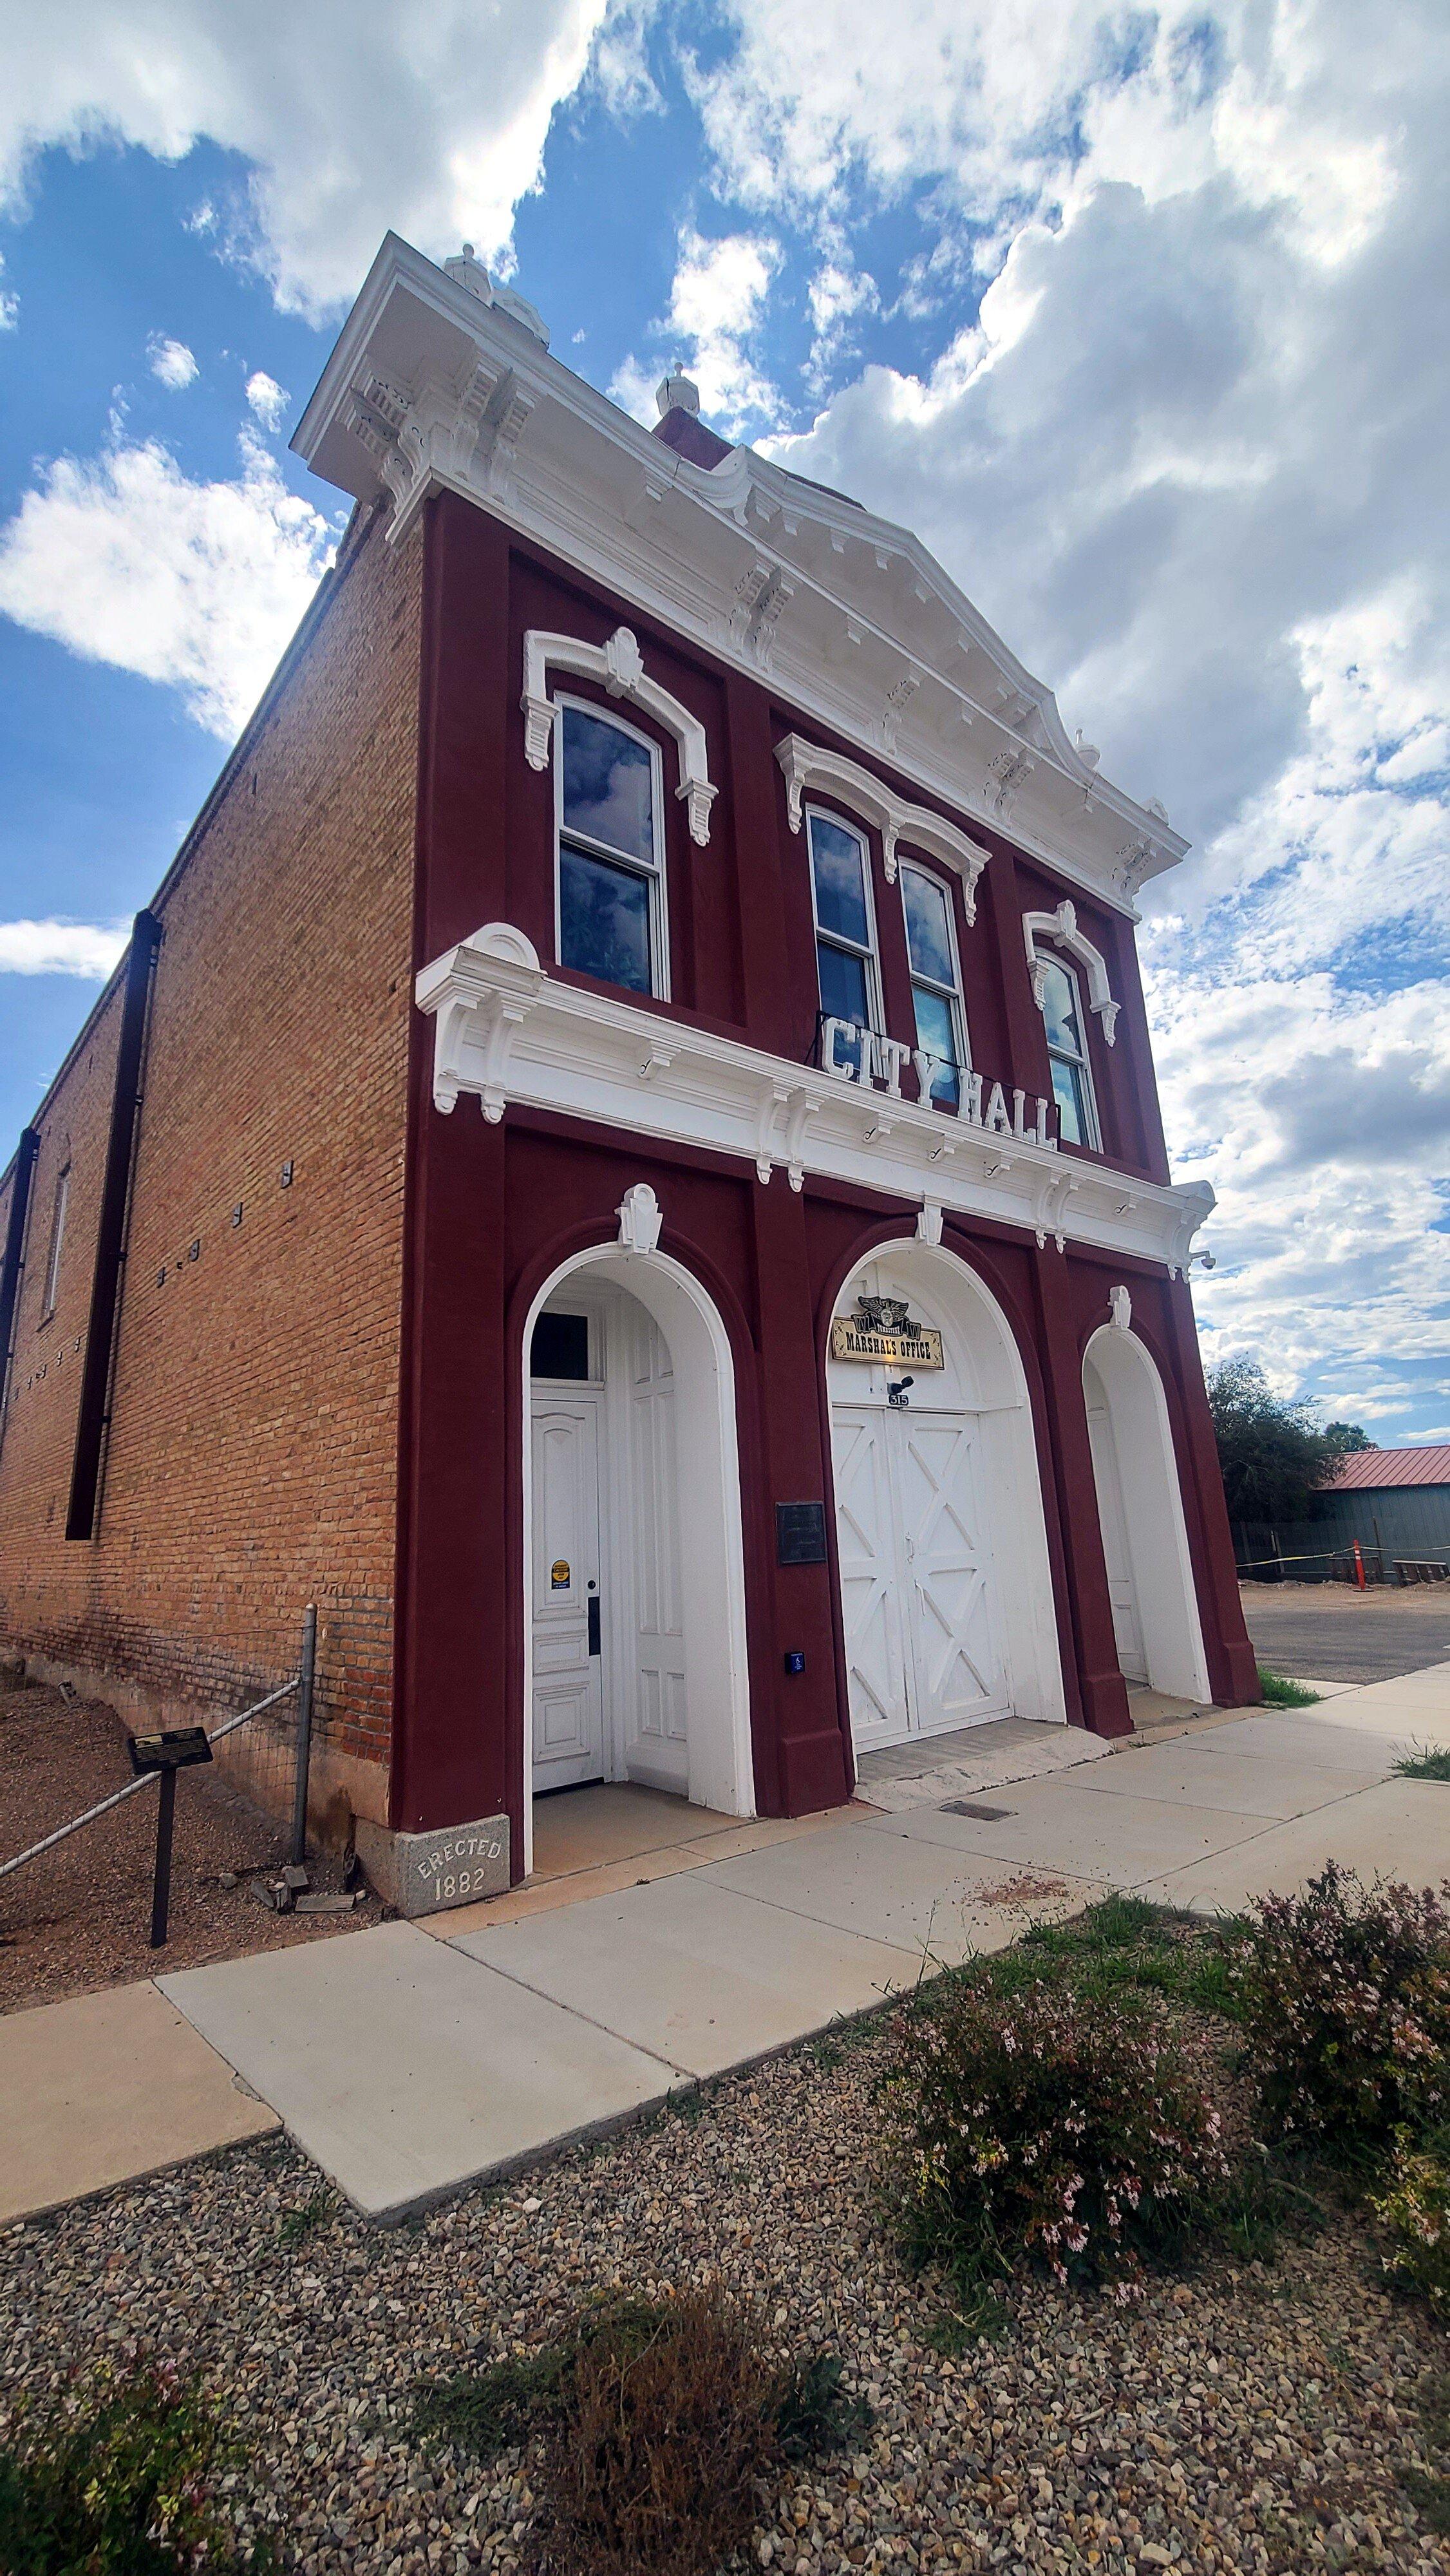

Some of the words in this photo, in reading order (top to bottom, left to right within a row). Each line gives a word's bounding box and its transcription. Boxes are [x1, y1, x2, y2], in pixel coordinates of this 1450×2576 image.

[822, 1017, 940, 1110] CITY
[957, 1067, 1058, 1151] HALL
[845, 1332, 897, 1356] MARSHAL'S
[900, 1341, 931, 1359] OFFICE
[890, 1395, 908, 1405] 315
[418, 1839, 501, 1879] ERECTED
[435, 1868, 484, 1900] 1882
